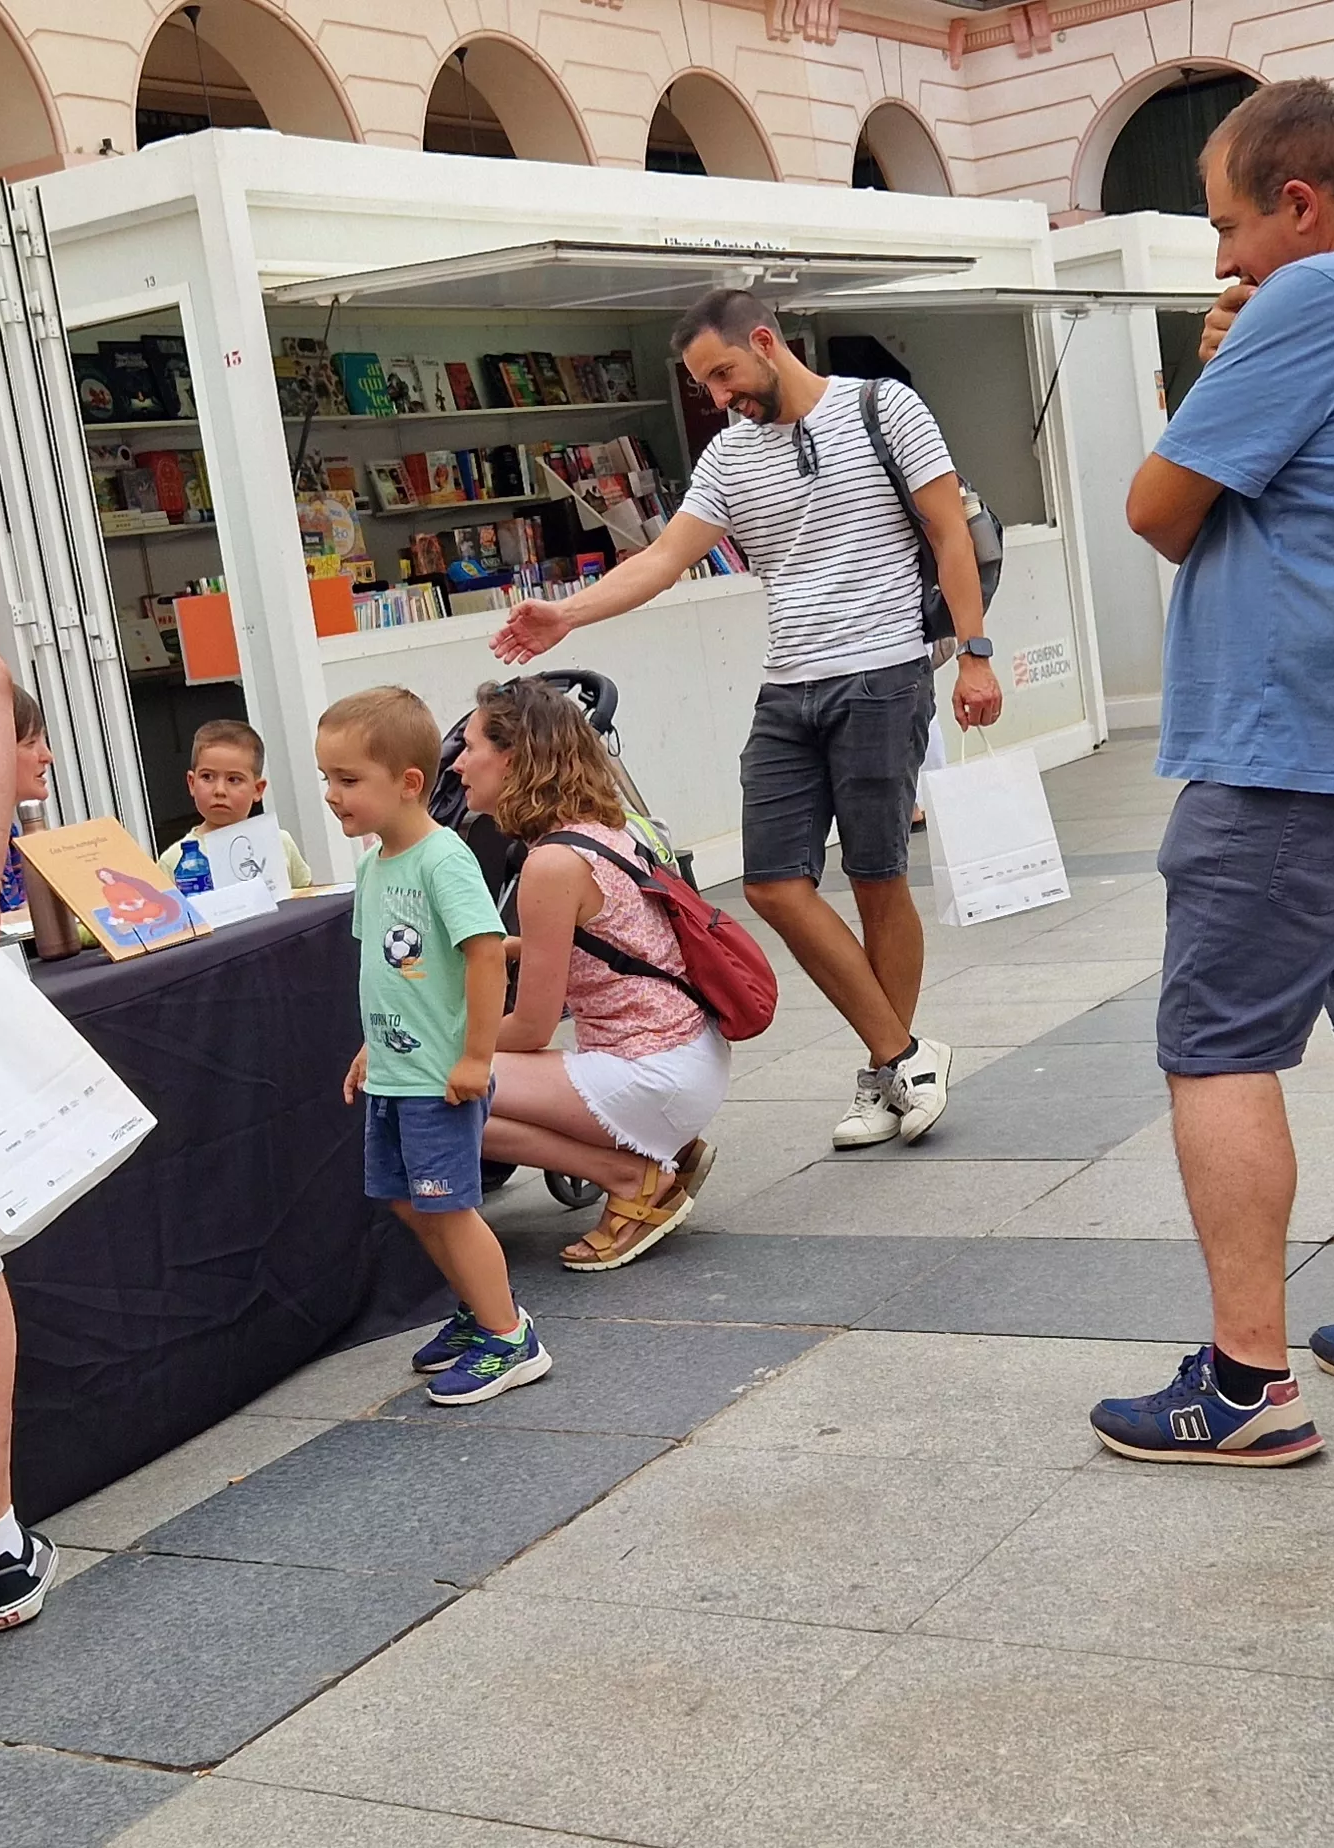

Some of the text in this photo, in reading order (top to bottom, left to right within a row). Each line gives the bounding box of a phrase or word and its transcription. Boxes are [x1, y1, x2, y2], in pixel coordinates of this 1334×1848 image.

[144, 276, 156, 288] 13
[224, 350, 242, 368] 15
[407, 888, 423, 899] FOR
[388, 1013, 402, 1027] TO
